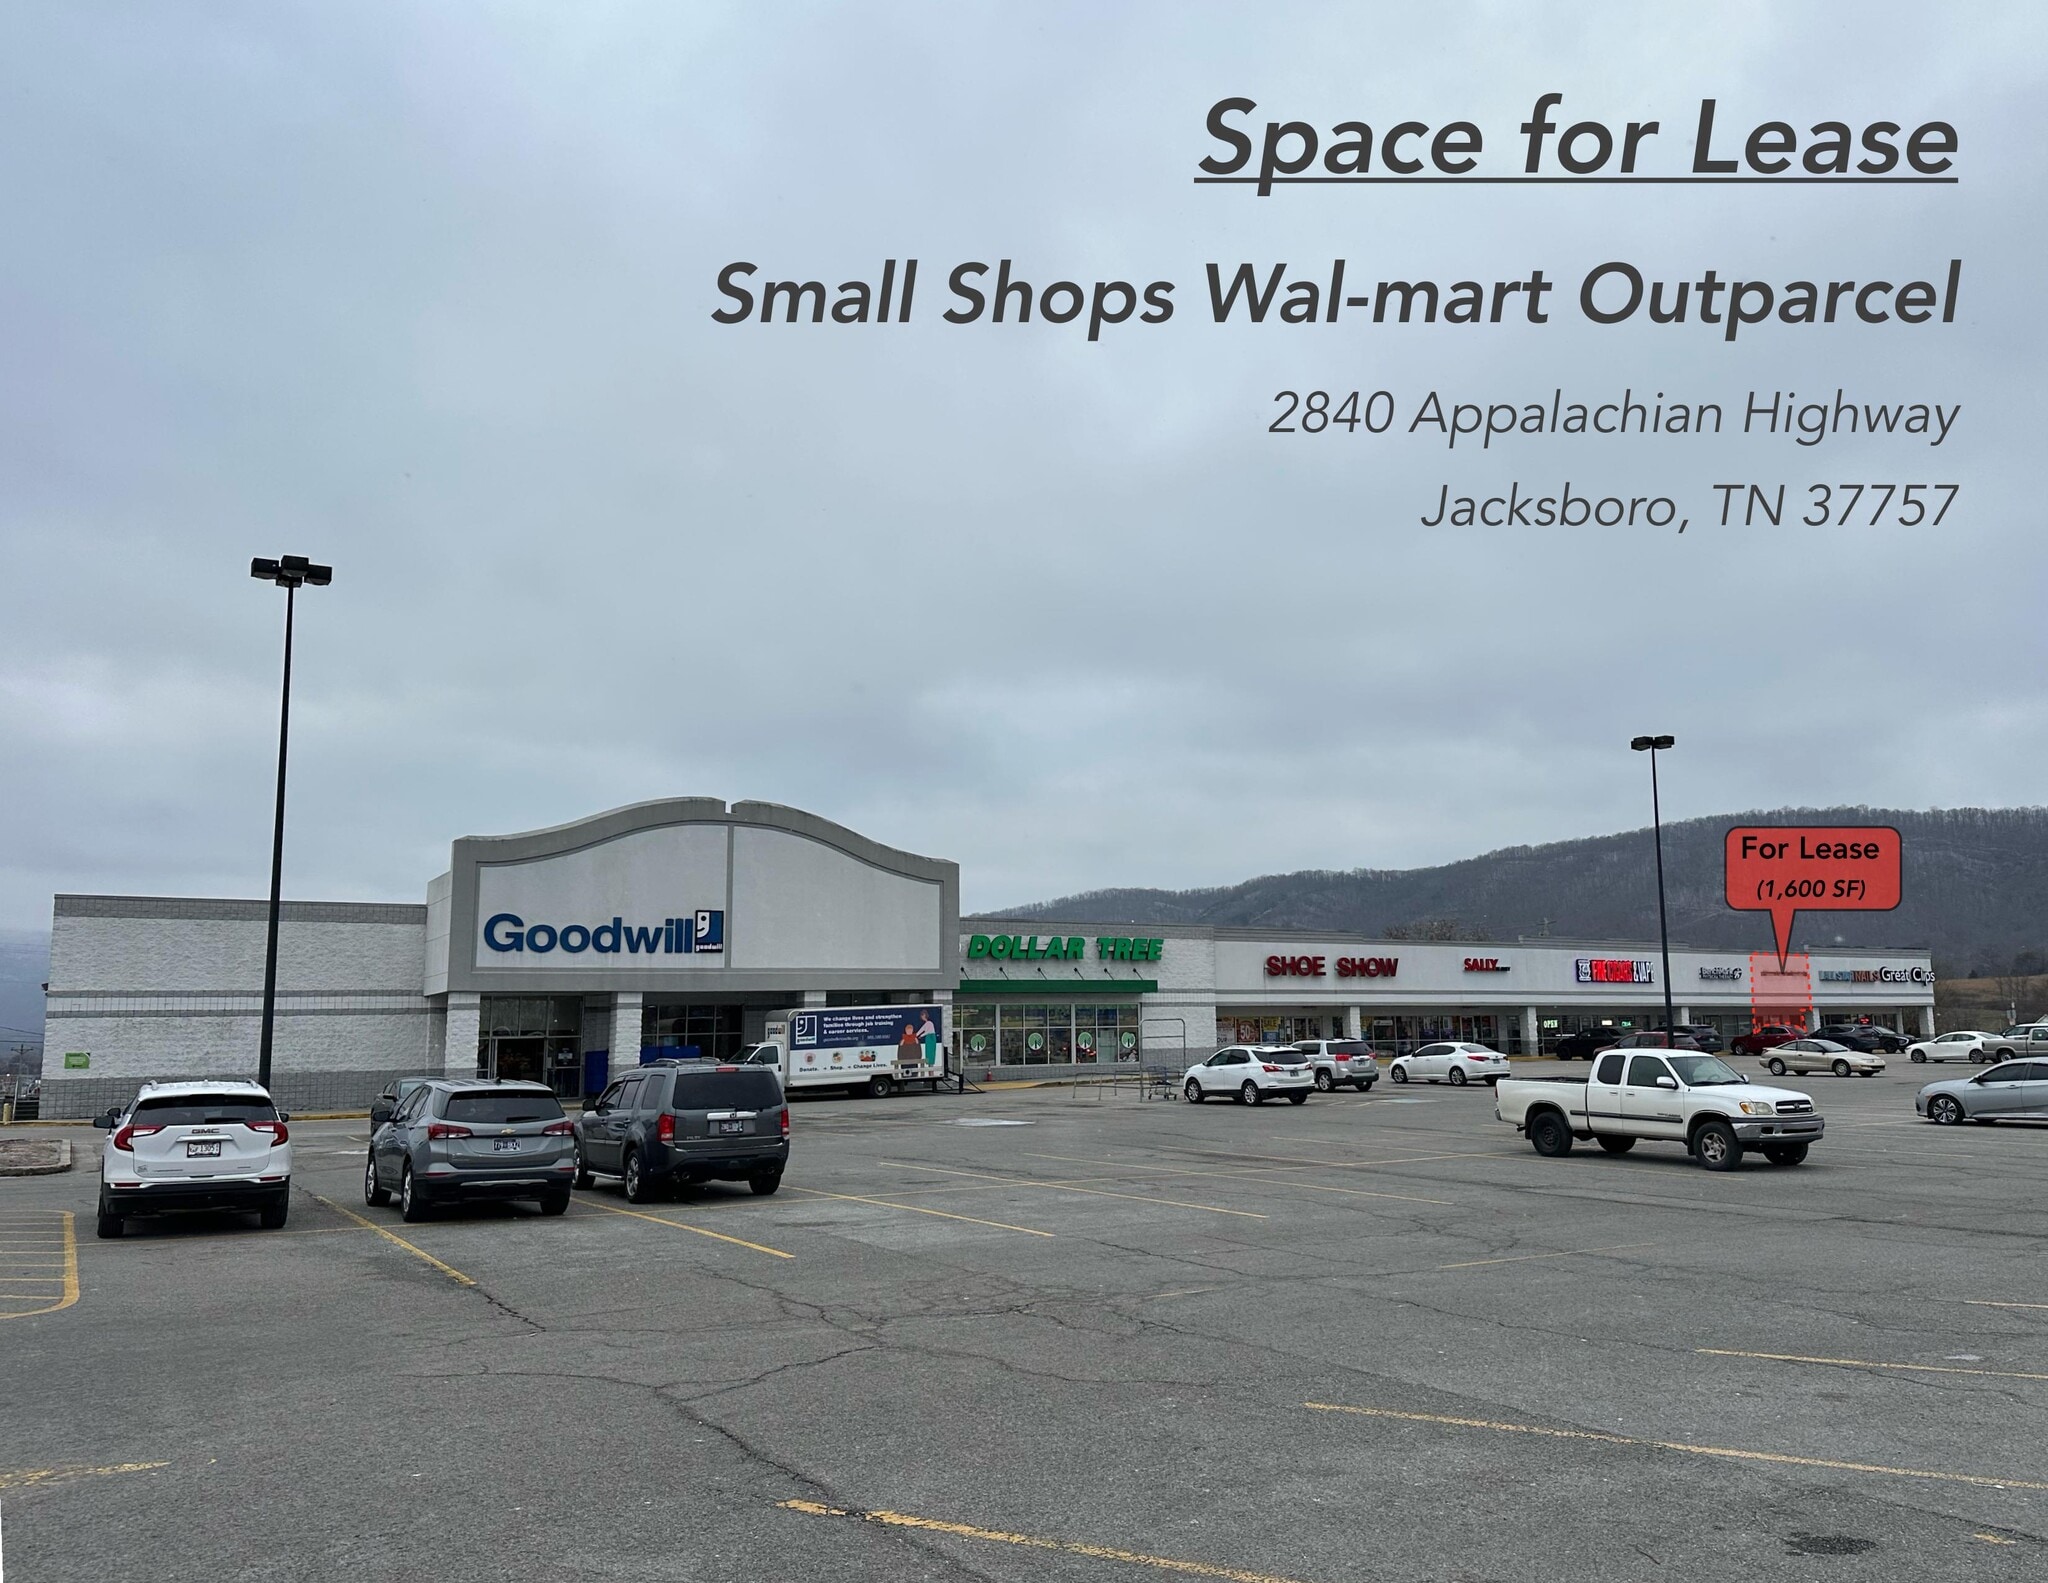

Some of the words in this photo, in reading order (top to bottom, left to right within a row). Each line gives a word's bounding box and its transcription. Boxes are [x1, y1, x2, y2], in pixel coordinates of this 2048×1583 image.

[484, 913, 693, 953] Goodwill
[967, 934, 1086, 961] DOLLAR
[1096, 936, 1165, 961] TREE
[1265, 955, 1327, 977] SHOE
[1336, 957, 1399, 978] SHOW
[1464, 957, 1499, 971] SALLY
[1880, 966, 1910, 982] Great
[1911, 966, 1936, 986] Clips
[1543, 1020, 1558, 1028] OPEN
